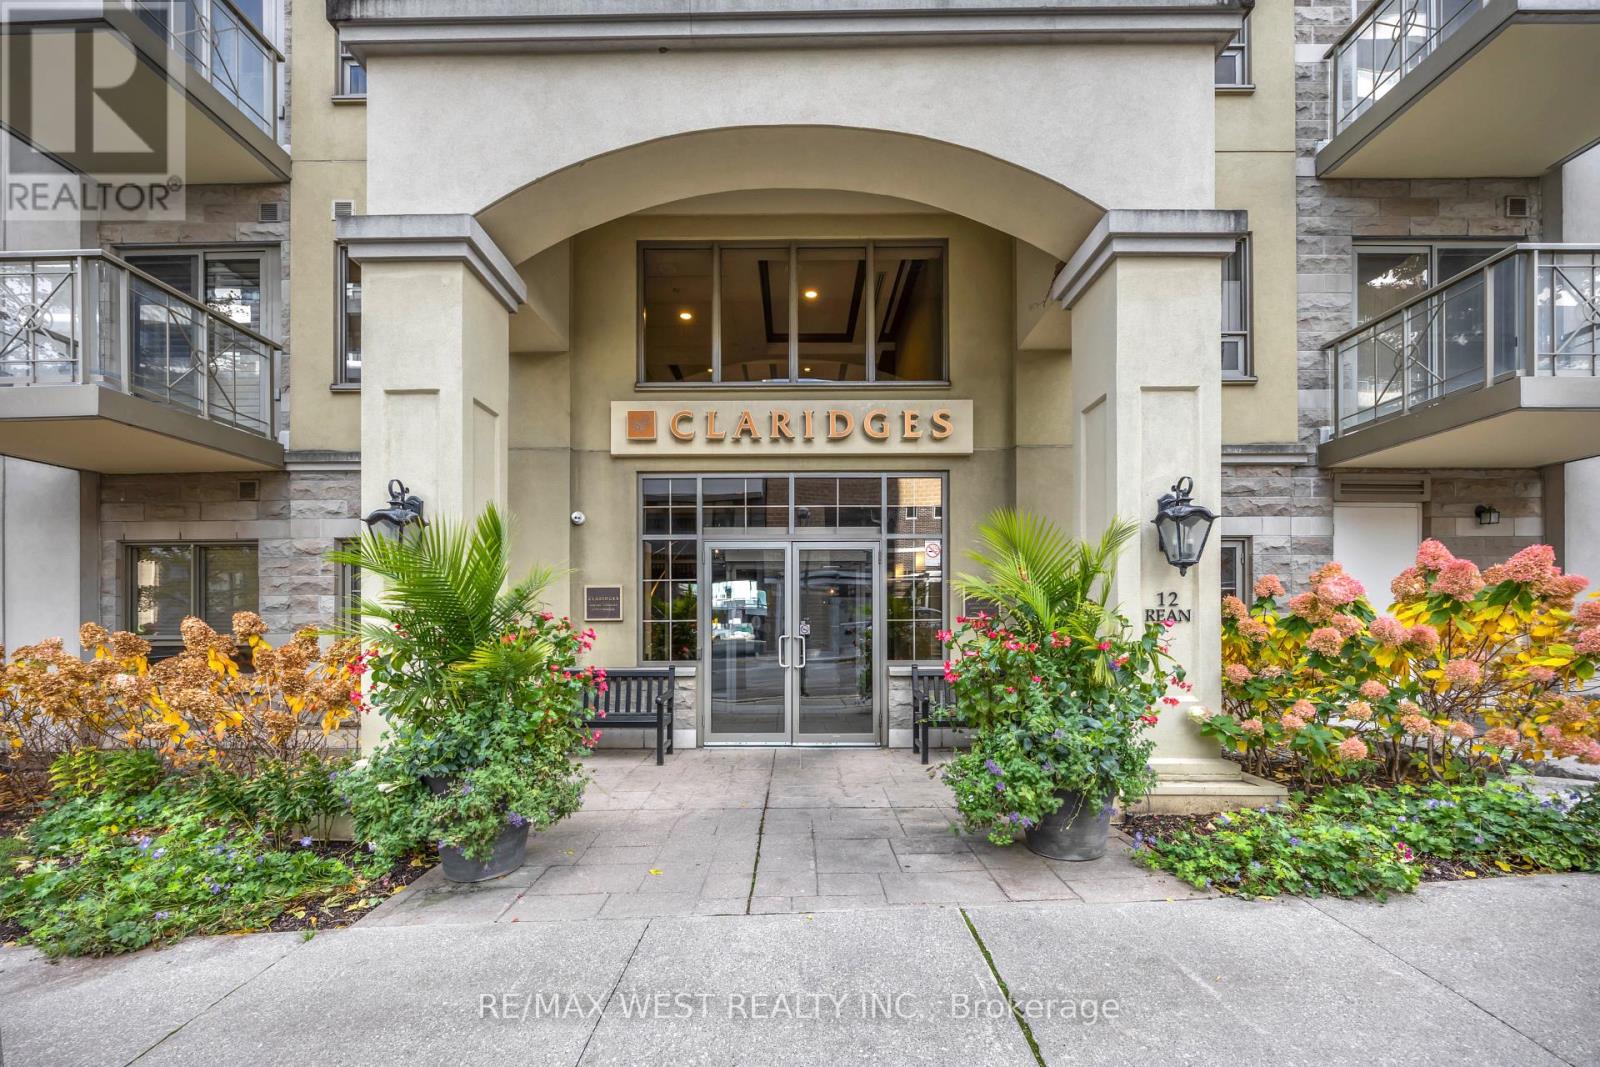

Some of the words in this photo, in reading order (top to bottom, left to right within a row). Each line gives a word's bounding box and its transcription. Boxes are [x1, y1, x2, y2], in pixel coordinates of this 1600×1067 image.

[669, 408, 954, 440] CLARIDGES
[1157, 591, 1178, 607] 12
[1145, 608, 1191, 622] REAN
